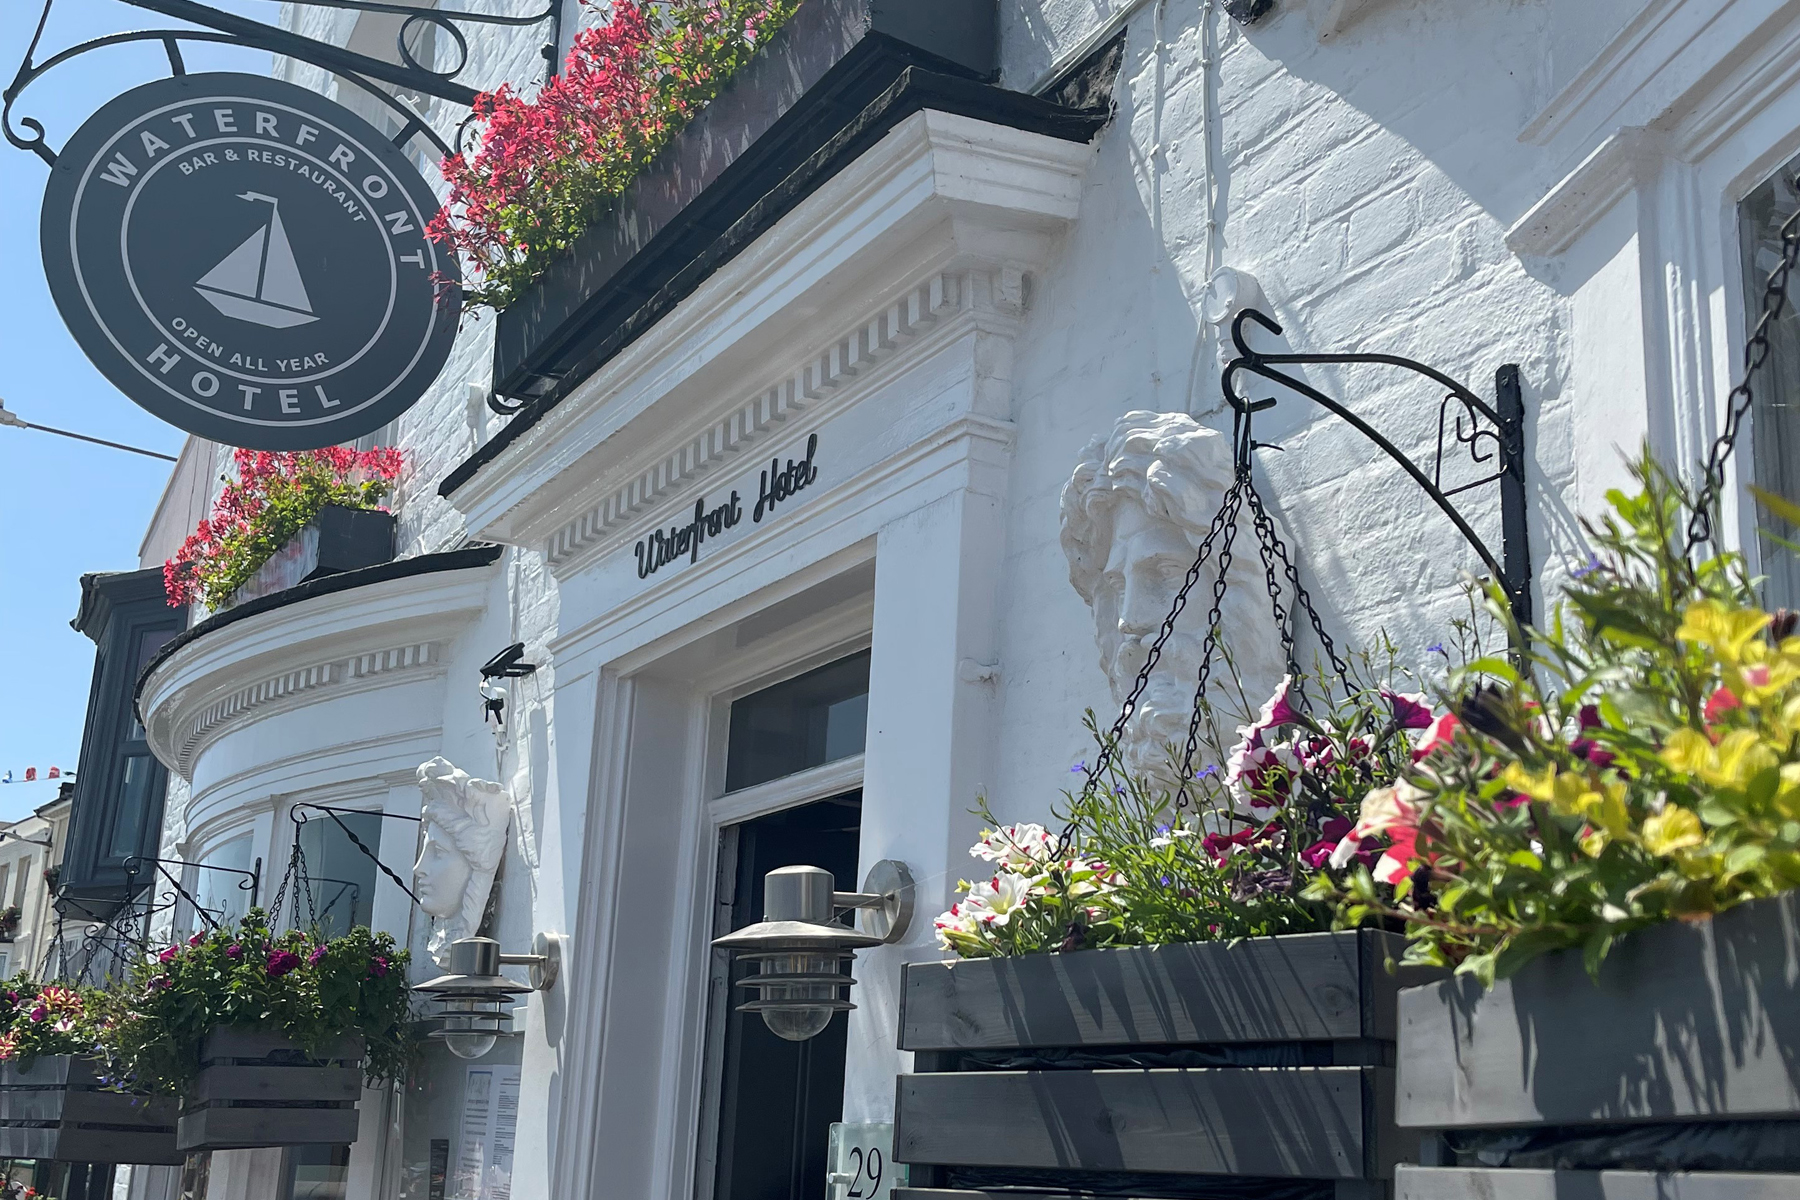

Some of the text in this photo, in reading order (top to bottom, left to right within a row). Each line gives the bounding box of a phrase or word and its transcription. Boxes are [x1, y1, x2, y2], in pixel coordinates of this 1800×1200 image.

[100, 109, 425, 269] WATERFRONT
[178, 148, 367, 224] BAR & RESTAURANT
[146, 342, 341, 414] HOTEL
[171, 316, 329, 372] OPEN ALL YEAR
[635, 433, 818, 579] Waterfront Hotel
[847, 1146, 883, 1200] 29
